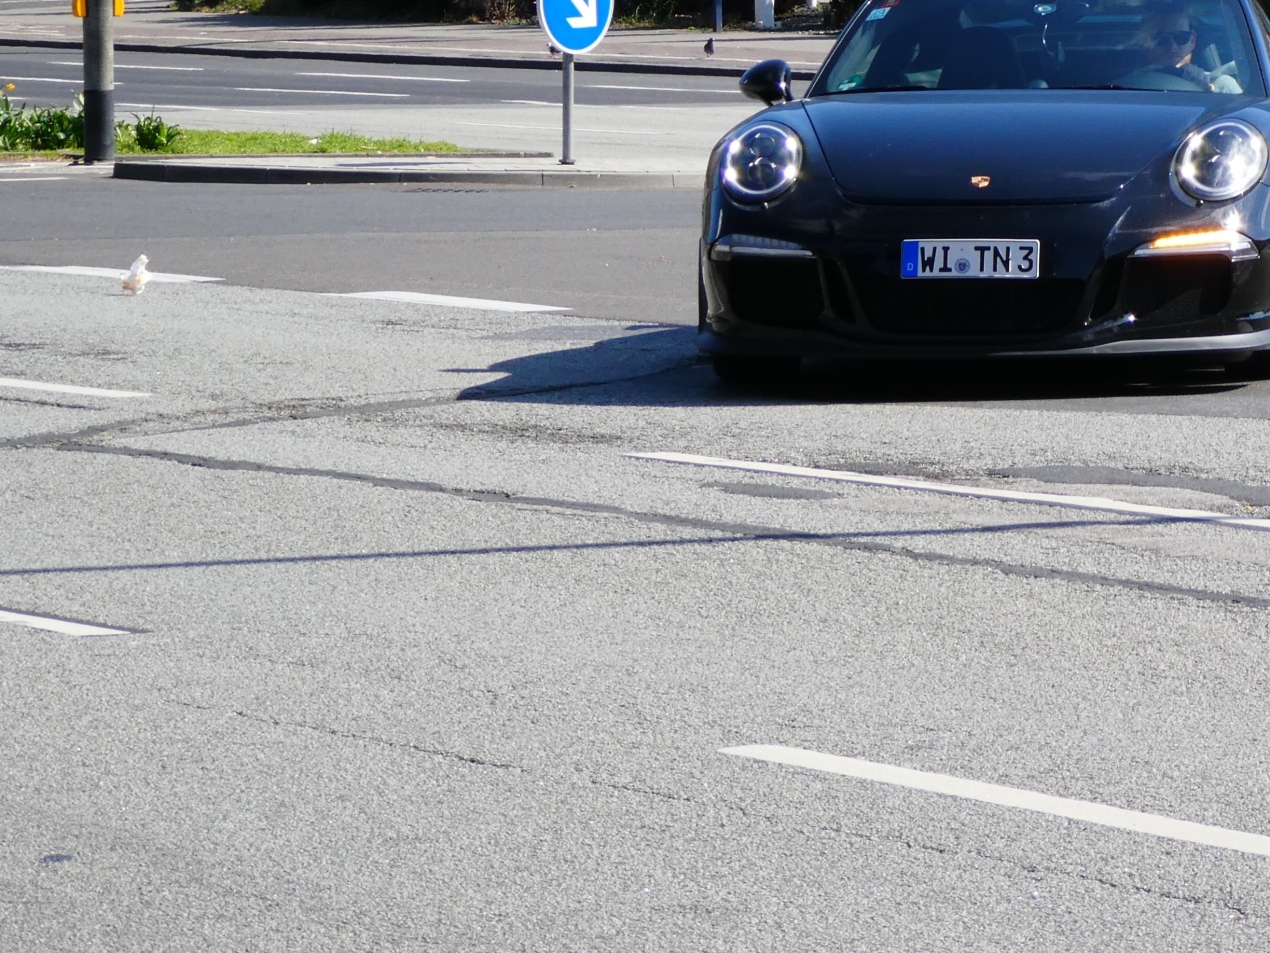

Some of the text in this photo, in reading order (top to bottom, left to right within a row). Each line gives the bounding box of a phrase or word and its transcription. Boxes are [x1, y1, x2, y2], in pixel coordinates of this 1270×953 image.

[920, 246, 952, 273] WI
[974, 246, 1010, 272] TN
[1017, 246, 1034, 273] 3
